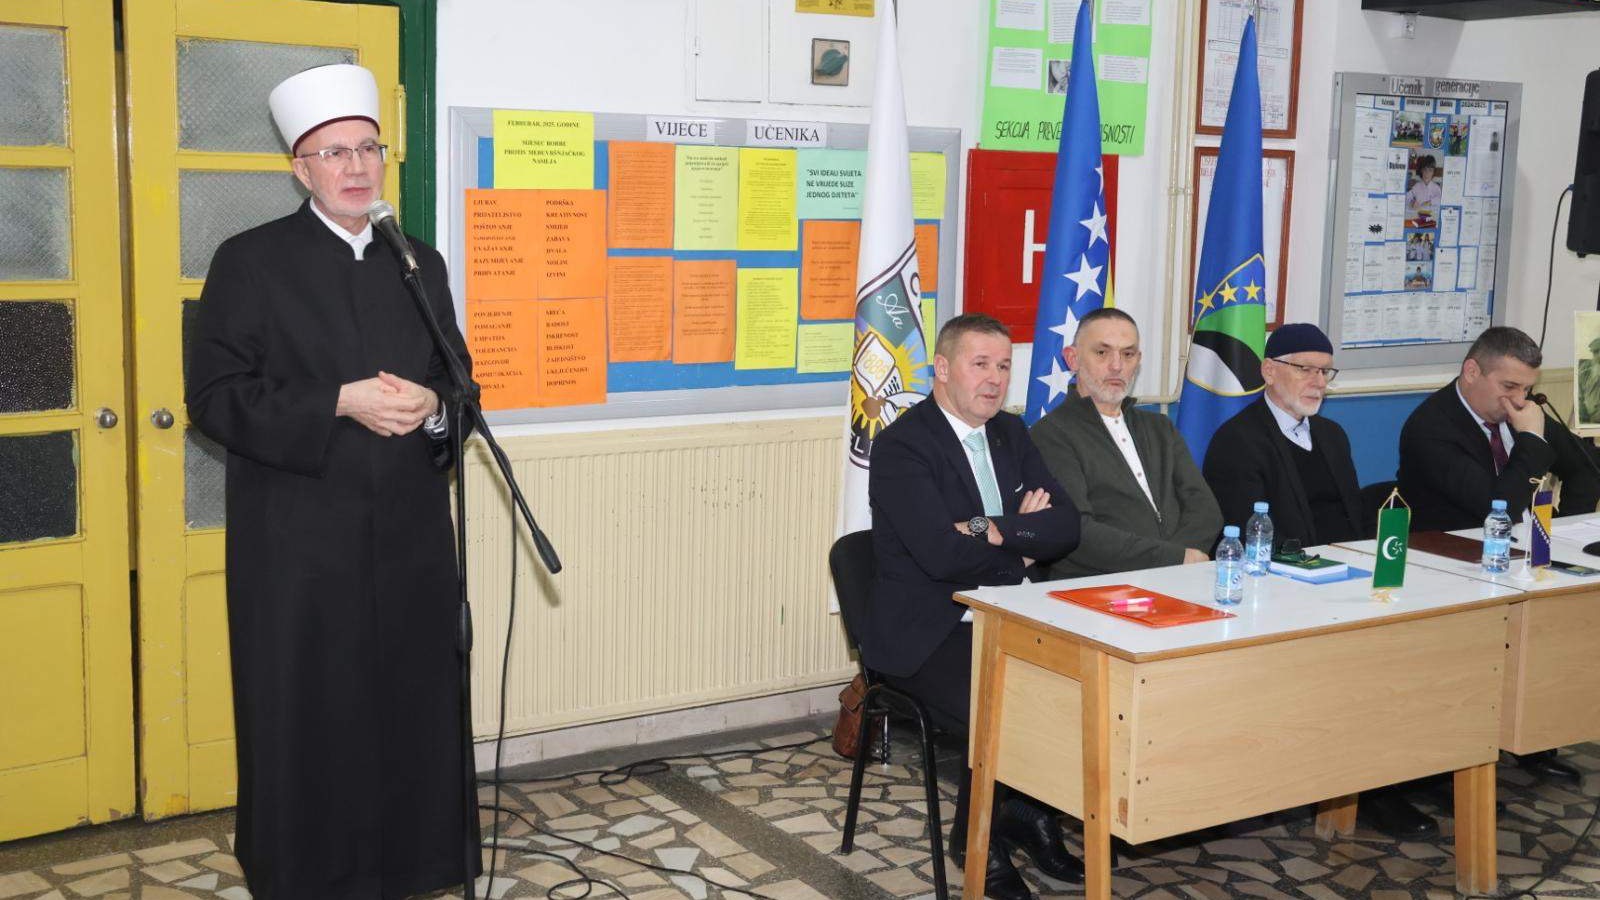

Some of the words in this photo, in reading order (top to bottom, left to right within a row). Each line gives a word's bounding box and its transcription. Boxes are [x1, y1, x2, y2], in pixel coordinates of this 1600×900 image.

[1435, 80, 1480, 97] generacije
[754, 124, 820, 142] UČENIKA
[1037, 121, 1063, 141] PREVE
[1102, 123, 1136, 144] SNOSTI
